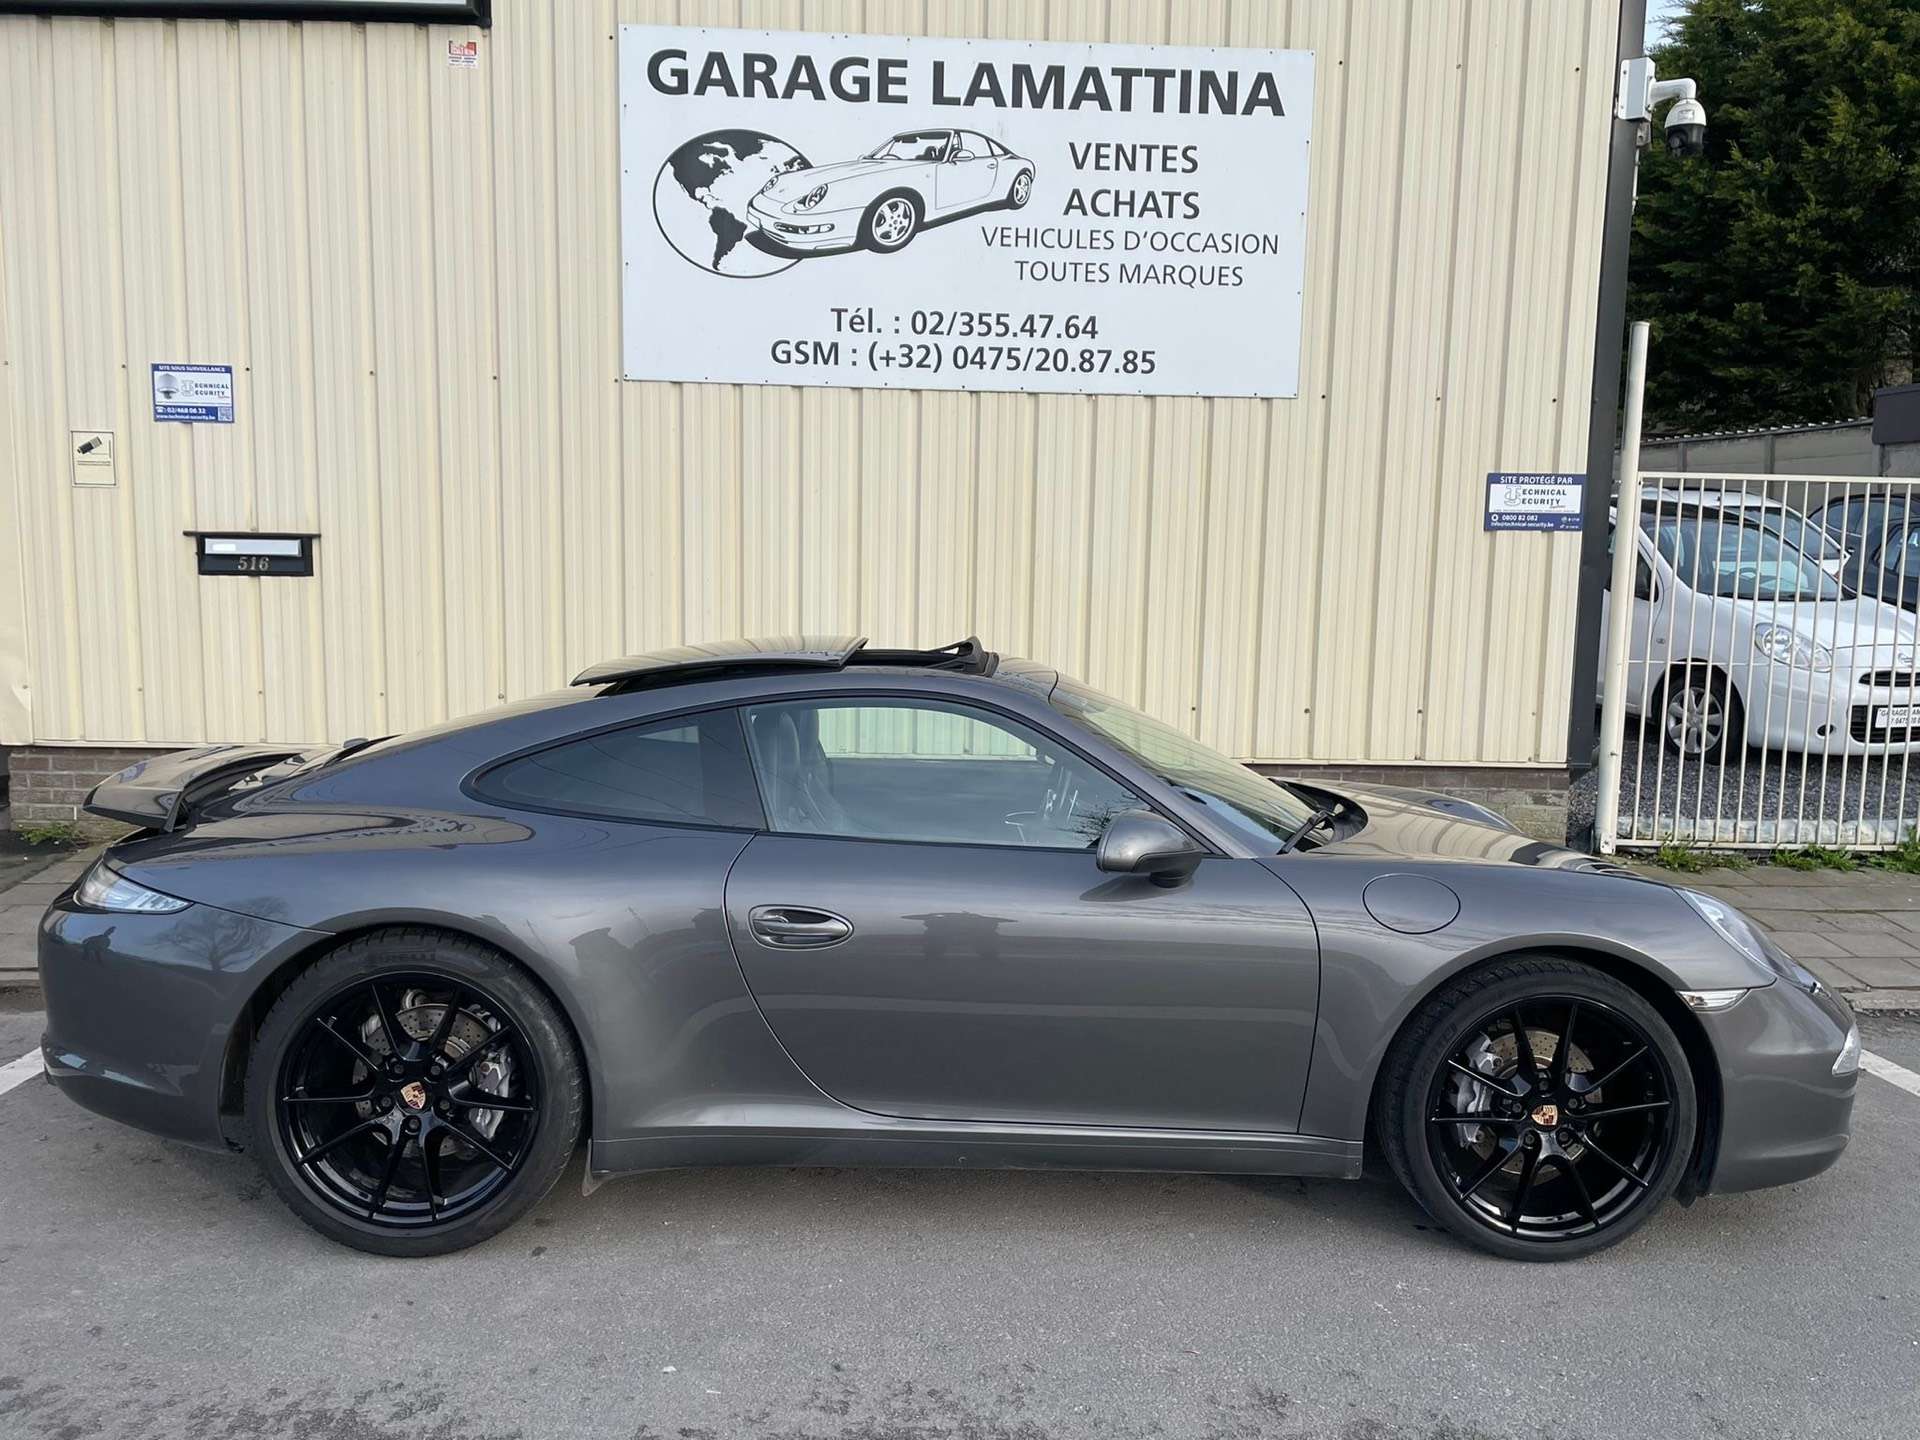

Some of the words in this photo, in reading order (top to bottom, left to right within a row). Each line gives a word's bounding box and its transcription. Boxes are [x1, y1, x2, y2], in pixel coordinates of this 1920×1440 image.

[646, 48, 908, 105] GARAGE
[932, 60, 1286, 117] LAMATTINA
[1068, 141, 1199, 174] VENTES
[1063, 188, 1200, 220] ACHATS
[981, 226, 1115, 250] VEHICULES
[1124, 230, 1279, 255] D'OCCASION
[1014, 260, 1110, 284] TOUTES
[1119, 263, 1243, 289] MARQUES
[830, 307, 882, 334] Tél.
[911, 310, 1099, 340] 02/355.47.64
[770, 339, 839, 366] GSM
[868, 340, 943, 374] (+32)
[952, 345, 1156, 375] 0475/20.87.85
[1500, 476, 1517, 484] SITE
[1519, 475, 1555, 484] PROTÉGÉ
[1557, 476, 1573, 484] PAR
